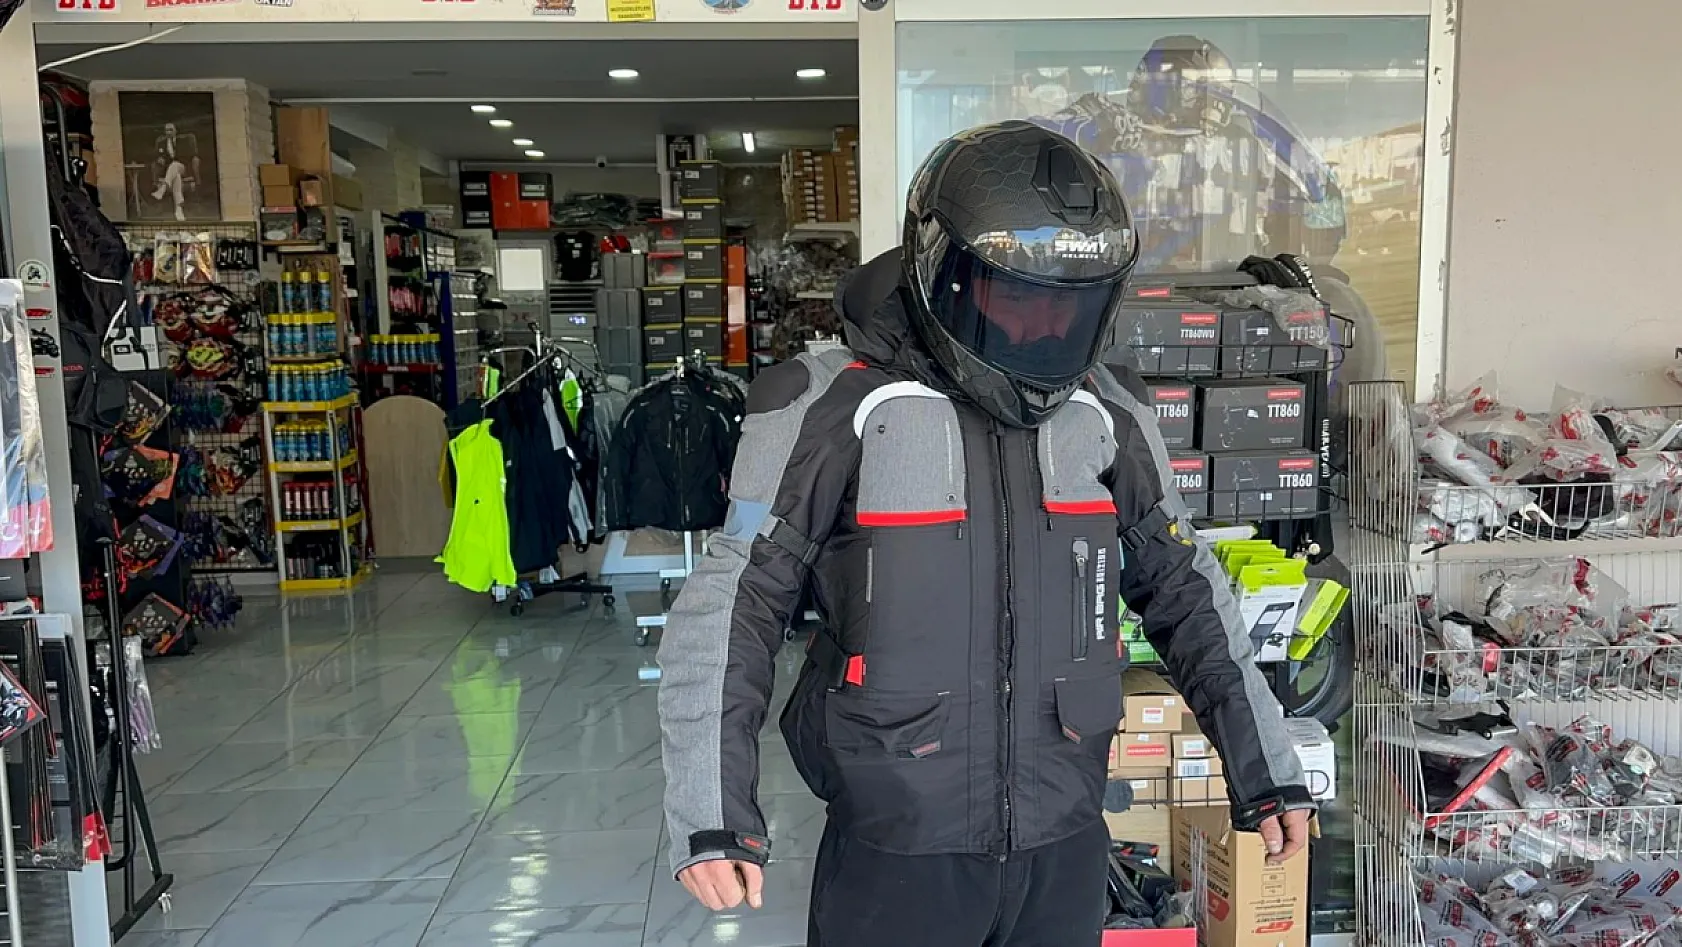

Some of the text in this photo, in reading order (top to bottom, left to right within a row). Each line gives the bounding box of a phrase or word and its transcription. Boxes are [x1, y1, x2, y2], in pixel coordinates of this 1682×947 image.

[1155, 403, 1189, 418] TT860
[1267, 403, 1300, 418] TT860
[1173, 474, 1202, 488] T860
[1278, 473, 1313, 488] TT860
[1095, 583, 1105, 615] BAG
